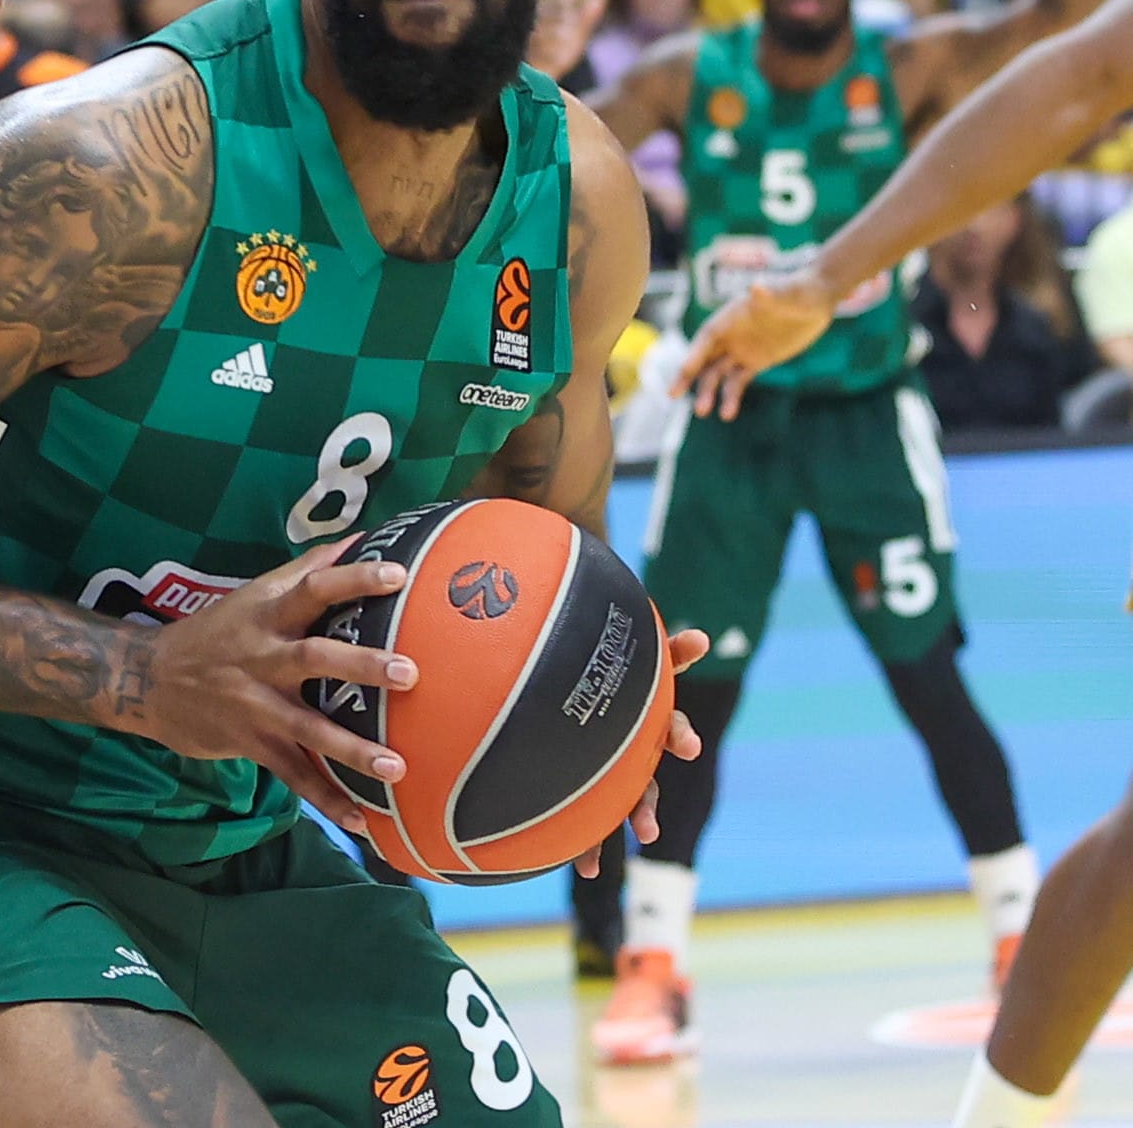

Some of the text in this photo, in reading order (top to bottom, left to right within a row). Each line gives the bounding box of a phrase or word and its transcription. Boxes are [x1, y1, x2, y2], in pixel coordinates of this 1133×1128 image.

[759, 148, 816, 225] 5
[494, 342, 528, 358] AIRLINES
[495, 329, 529, 347] TURKISH
[493, 352, 529, 370] EuroLeague
[210, 368, 275, 394] adidas
[461, 384, 529, 411] oneteam
[286, 412, 393, 544] 8
[881, 535, 938, 618] 5
[446, 968, 534, 1111] 8
[381, 1088, 435, 1121] TURKISH
[384, 1098, 436, 1128] AIRLINES
